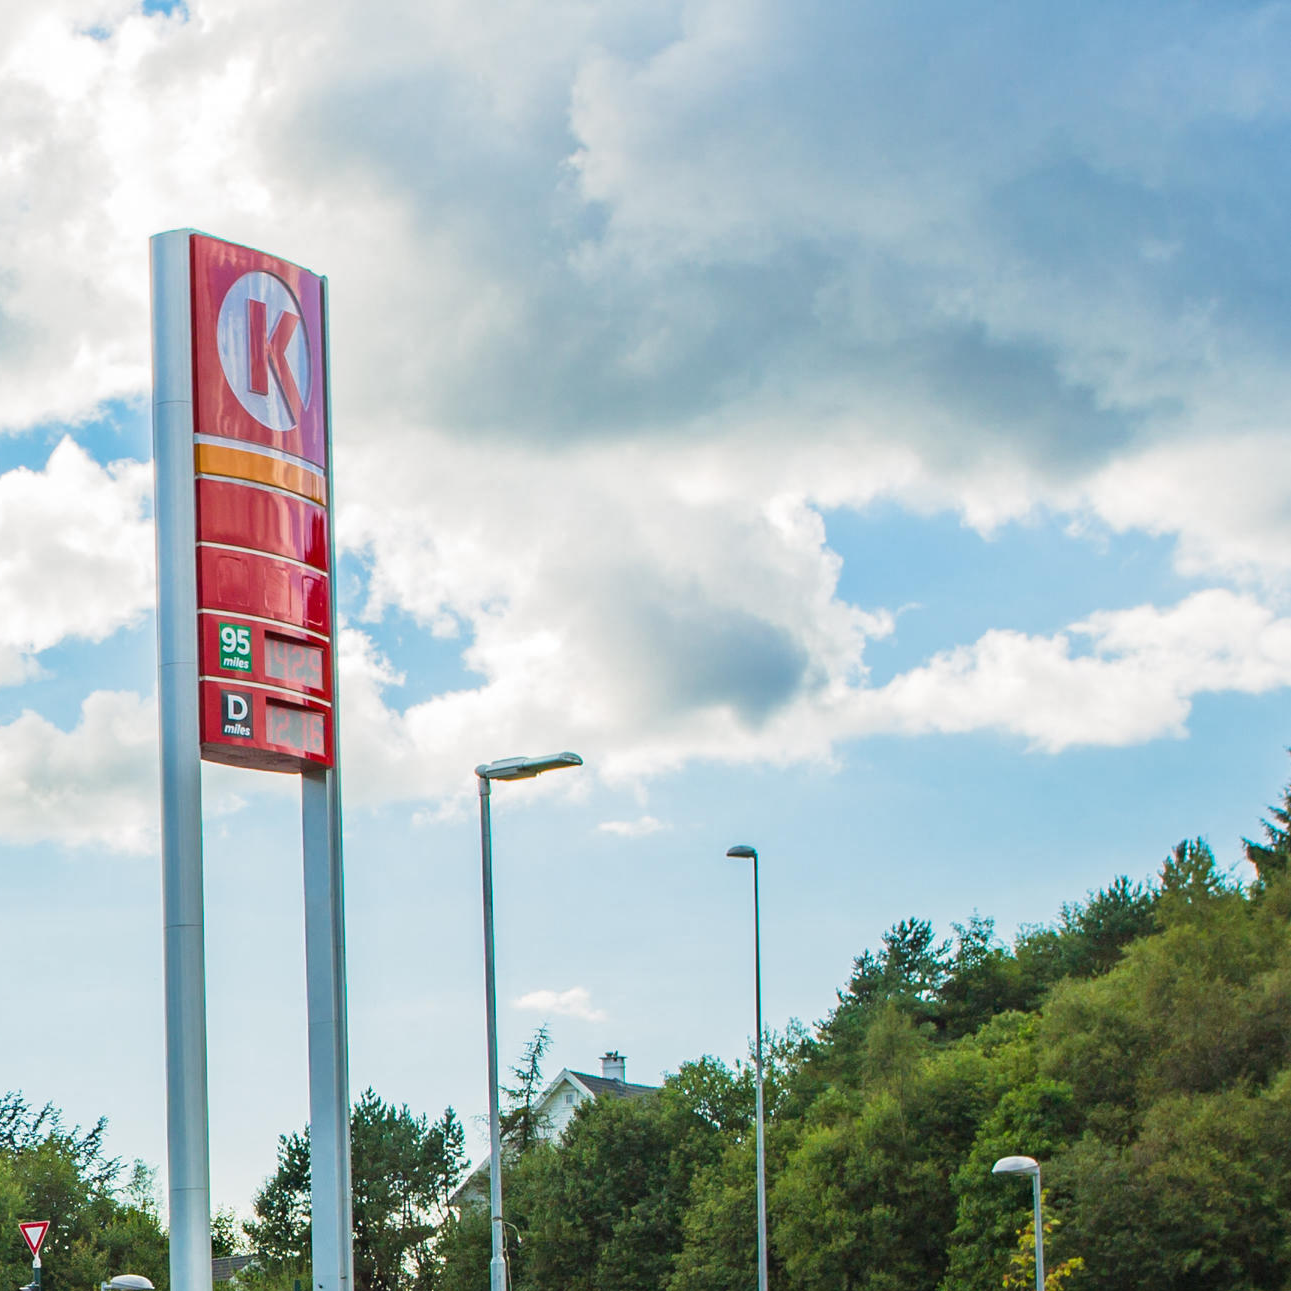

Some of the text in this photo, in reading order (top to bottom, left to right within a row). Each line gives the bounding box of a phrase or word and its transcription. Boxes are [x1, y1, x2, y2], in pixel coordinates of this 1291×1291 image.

[221, 627, 250, 655] 95
[223, 657, 249, 669] miles
[227, 694, 248, 720] D
[224, 724, 251, 736] miles
